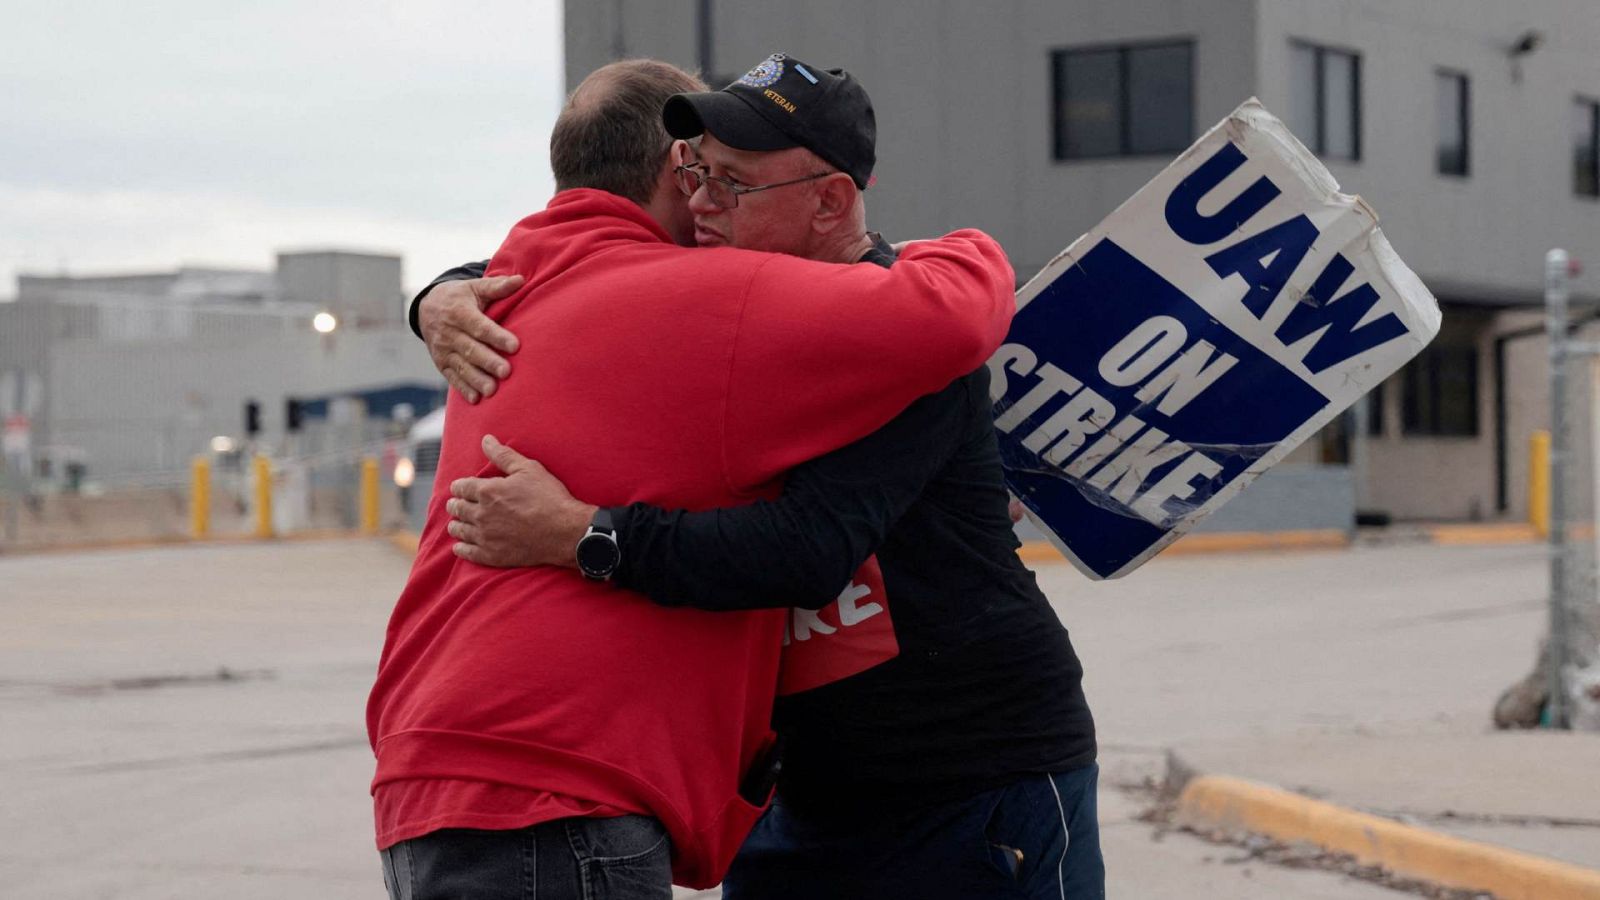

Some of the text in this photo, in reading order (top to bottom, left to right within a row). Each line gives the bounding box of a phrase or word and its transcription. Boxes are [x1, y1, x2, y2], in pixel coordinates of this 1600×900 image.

[764, 89, 797, 113] VETERAN
[1165, 141, 1409, 375] UAW
[1098, 315, 1239, 417] ON
[986, 343, 1224, 529] STRIKE
[784, 580, 883, 646] KE
